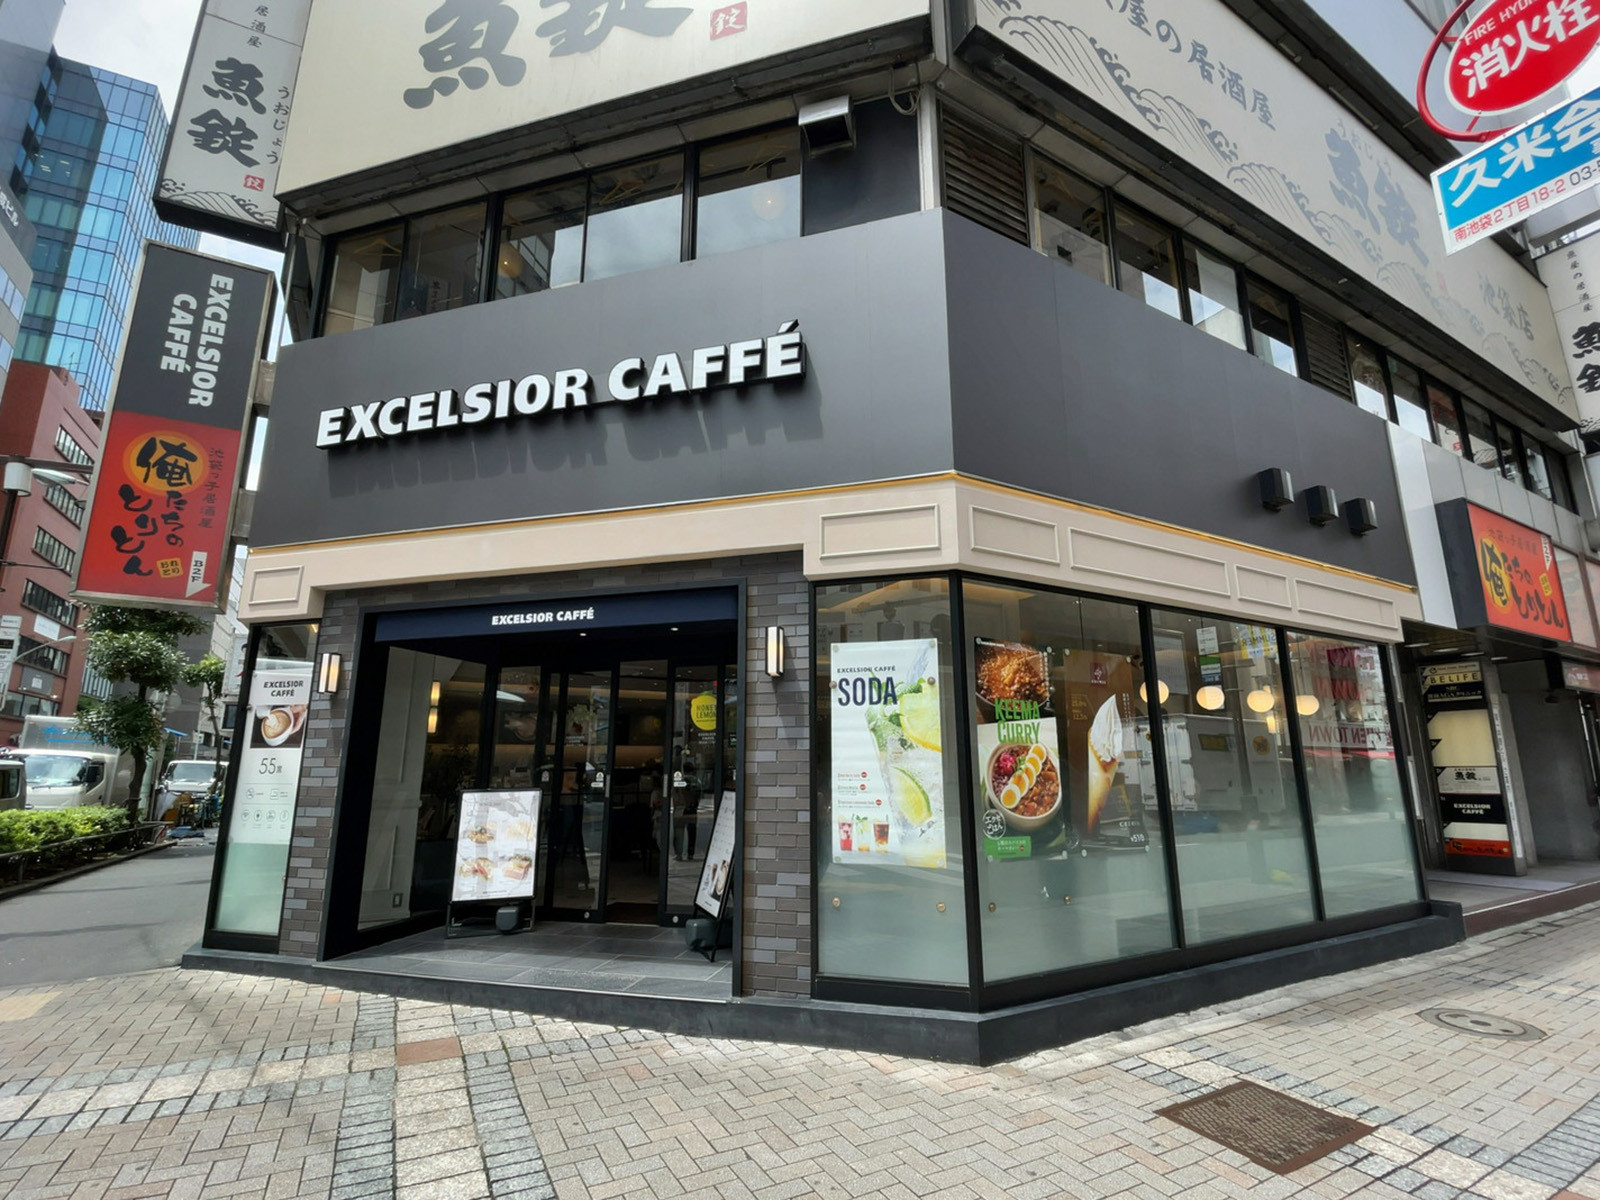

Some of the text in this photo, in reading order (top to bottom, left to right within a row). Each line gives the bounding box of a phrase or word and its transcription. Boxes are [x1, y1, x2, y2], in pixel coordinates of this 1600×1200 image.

[1464, 18, 1497, 46] FIRE
[1459, 0, 1600, 98] 消火栓
[1106, 0, 1276, 131] 屋の居酒屋
[160, 293, 198, 374] CAFFÉ
[188, 273, 234, 407] EXCELSIOR
[316, 319, 805, 449] EXCELSIOR CAFFÉ
[191, 560, 203, 583] B2F
[491, 606, 595, 626] EXCELSIOR CAFFÉ
[263, 680, 304, 689] EXCELSIOR
[837, 676, 898, 706] SODA
[1429, 672, 1479, 684] BELIFE
[270, 688, 295, 698] CAFFÉ
[996, 719, 1041, 745] CURRY
